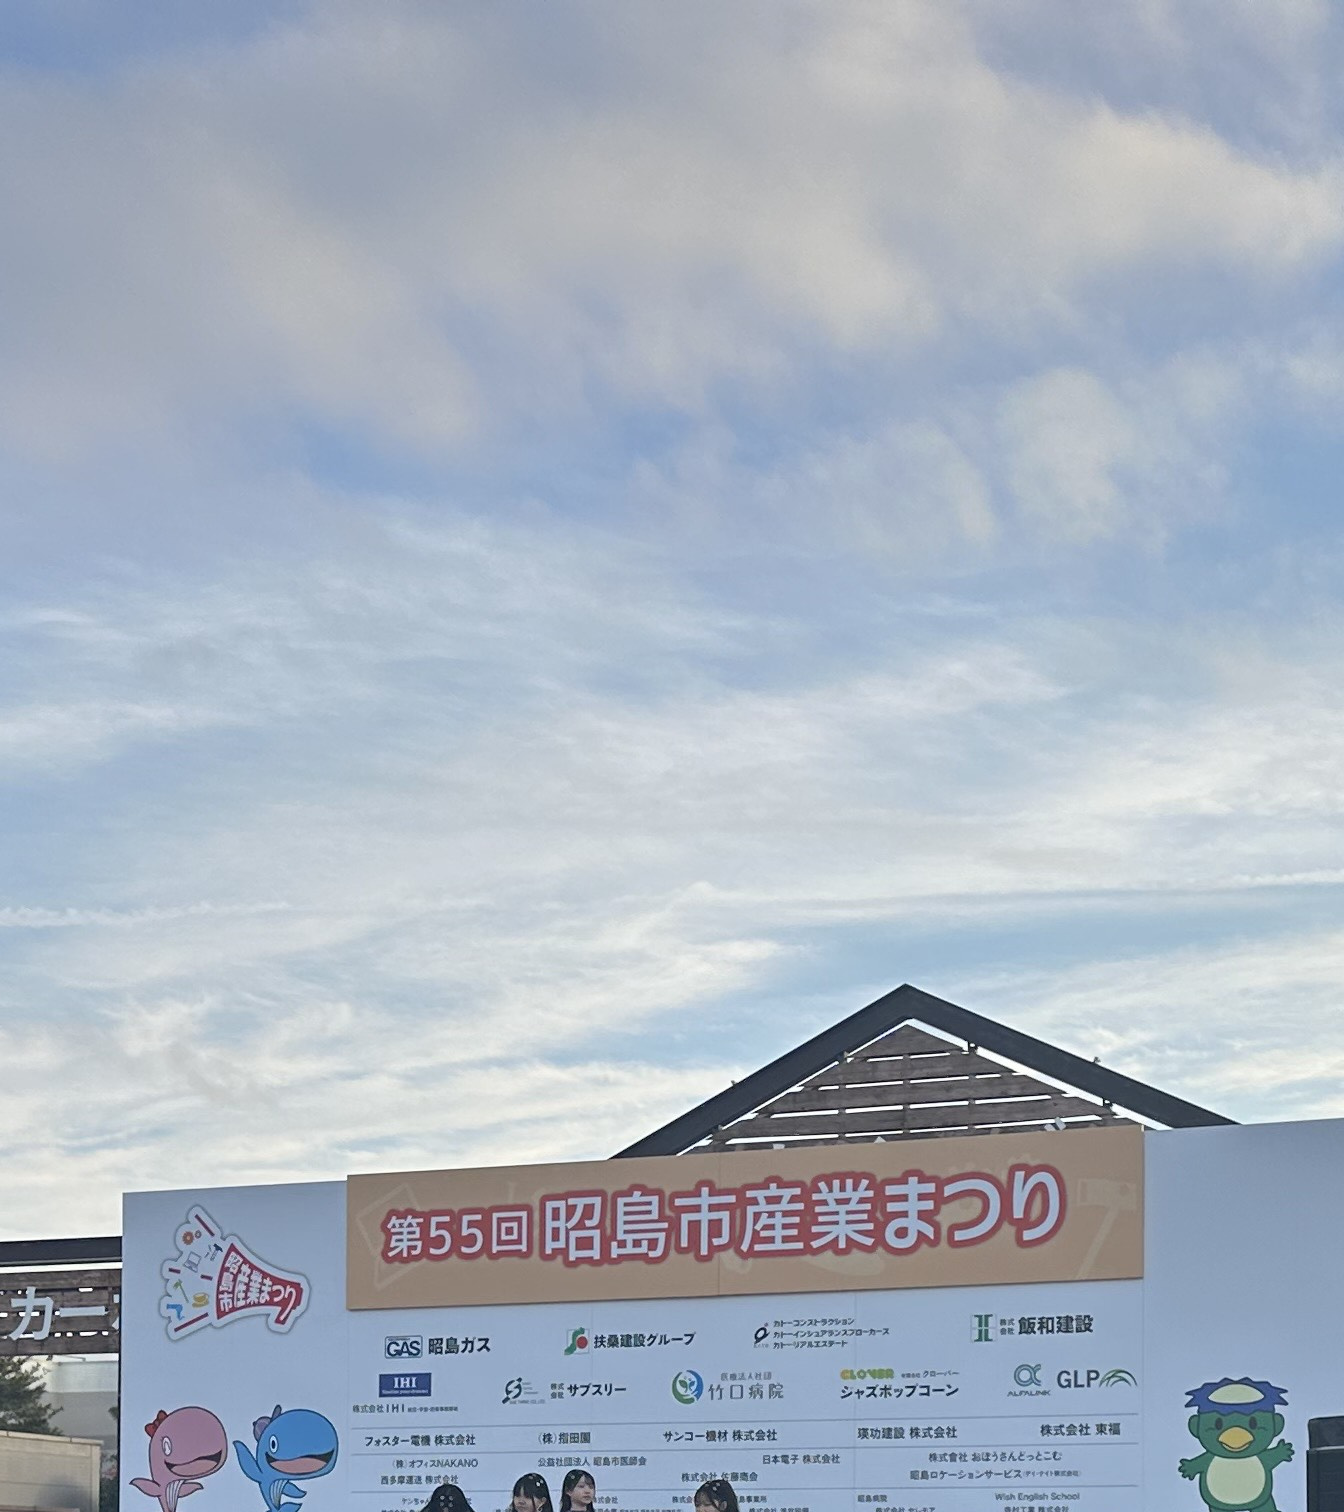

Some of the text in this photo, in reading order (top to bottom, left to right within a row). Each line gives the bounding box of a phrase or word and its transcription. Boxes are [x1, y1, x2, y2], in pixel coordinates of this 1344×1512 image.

[386, 1169, 1062, 1262] 第55回 昭島市産業まつり
[1018, 1315, 1094, 1335] 飯和建設
[428, 1337, 491, 1355] 昭島ガス
[594, 1331, 696, 1349] 扶桑建設グループ
[386, 1340, 421, 1357] GAS
[840, 1368, 895, 1380] CLOVER
[1057, 1369, 1100, 1389] GLP
[394, 1377, 417, 1389] IHI
[567, 1383, 626, 1398] サブスリー
[708, 1383, 784, 1400] 竹口病院
[840, 1383, 959, 1399] ジャズポップコーン
[663, 1429, 778, 1443] サンコー機材 株式会社
[909, 1425, 958, 1439] 株式会社
[1040, 1422, 1121, 1437] 株式会社 東福
[365, 1434, 476, 1447] フォスター電機 株式会社
[762, 1453, 841, 1465] 日本電子 株式会社
[995, 1493, 1016, 1501] Wish
[1018, 1492, 1048, 1502] English
